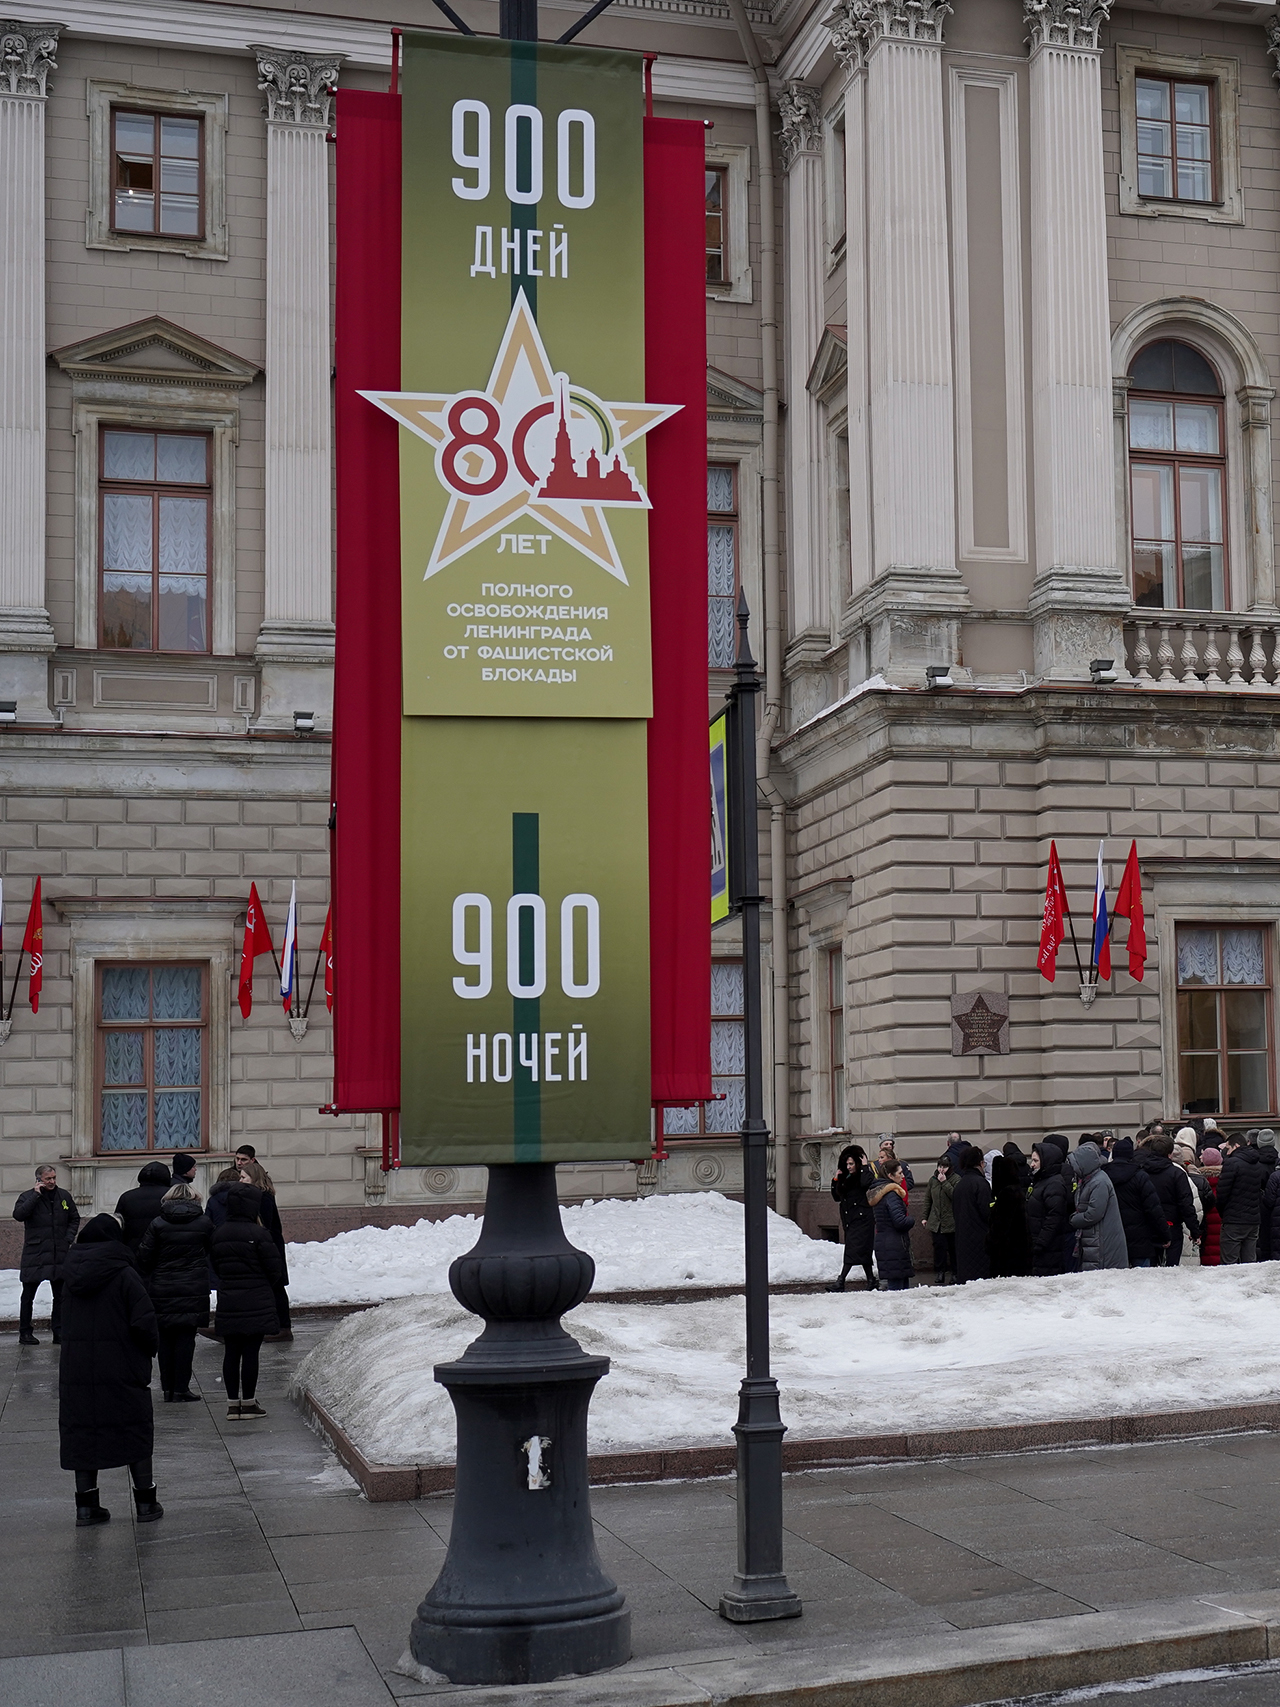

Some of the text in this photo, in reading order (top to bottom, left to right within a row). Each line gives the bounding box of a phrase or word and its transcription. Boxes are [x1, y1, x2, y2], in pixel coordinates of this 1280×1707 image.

[452, 99, 595, 209] 900
[470, 223, 568, 278] ДНЕЙ
[496, 533, 553, 555] ЛЕТ
[481, 582, 574, 599] ПОЛНОГО
[446, 602, 609, 621] ОСВОБОЖДЕНИЯ
[463, 624, 593, 642] ЛЕНИНГРАДА
[443, 644, 614, 662] ОТ ФАШИСТСКОЙ
[481, 667, 577, 684] БЛОКАДЫ
[452, 892, 601, 999] 900
[466, 1023, 588, 1083] НОЧЕЙ
